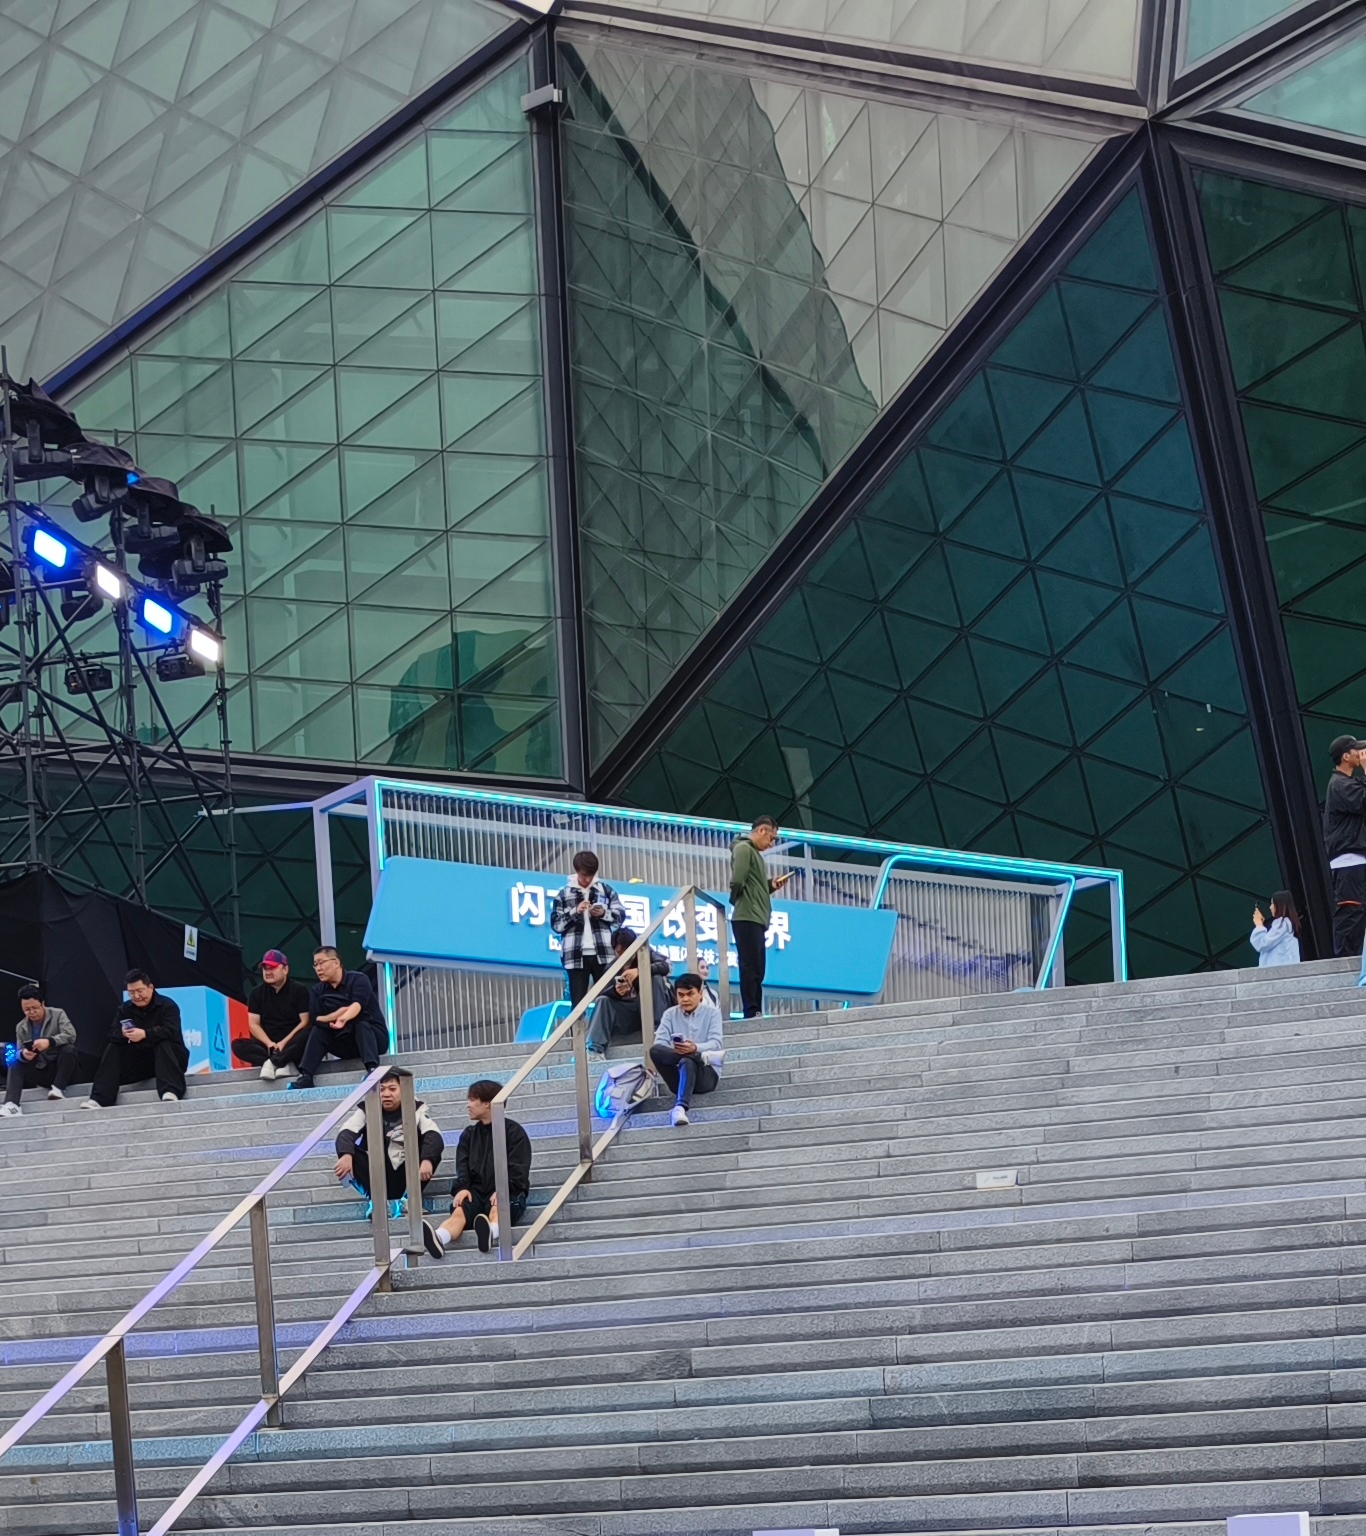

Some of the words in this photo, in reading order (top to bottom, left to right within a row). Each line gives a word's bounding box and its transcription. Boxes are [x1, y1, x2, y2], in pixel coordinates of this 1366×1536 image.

[511, 881, 651, 934] 闪国
[661, 899, 791, 950] 改变界
